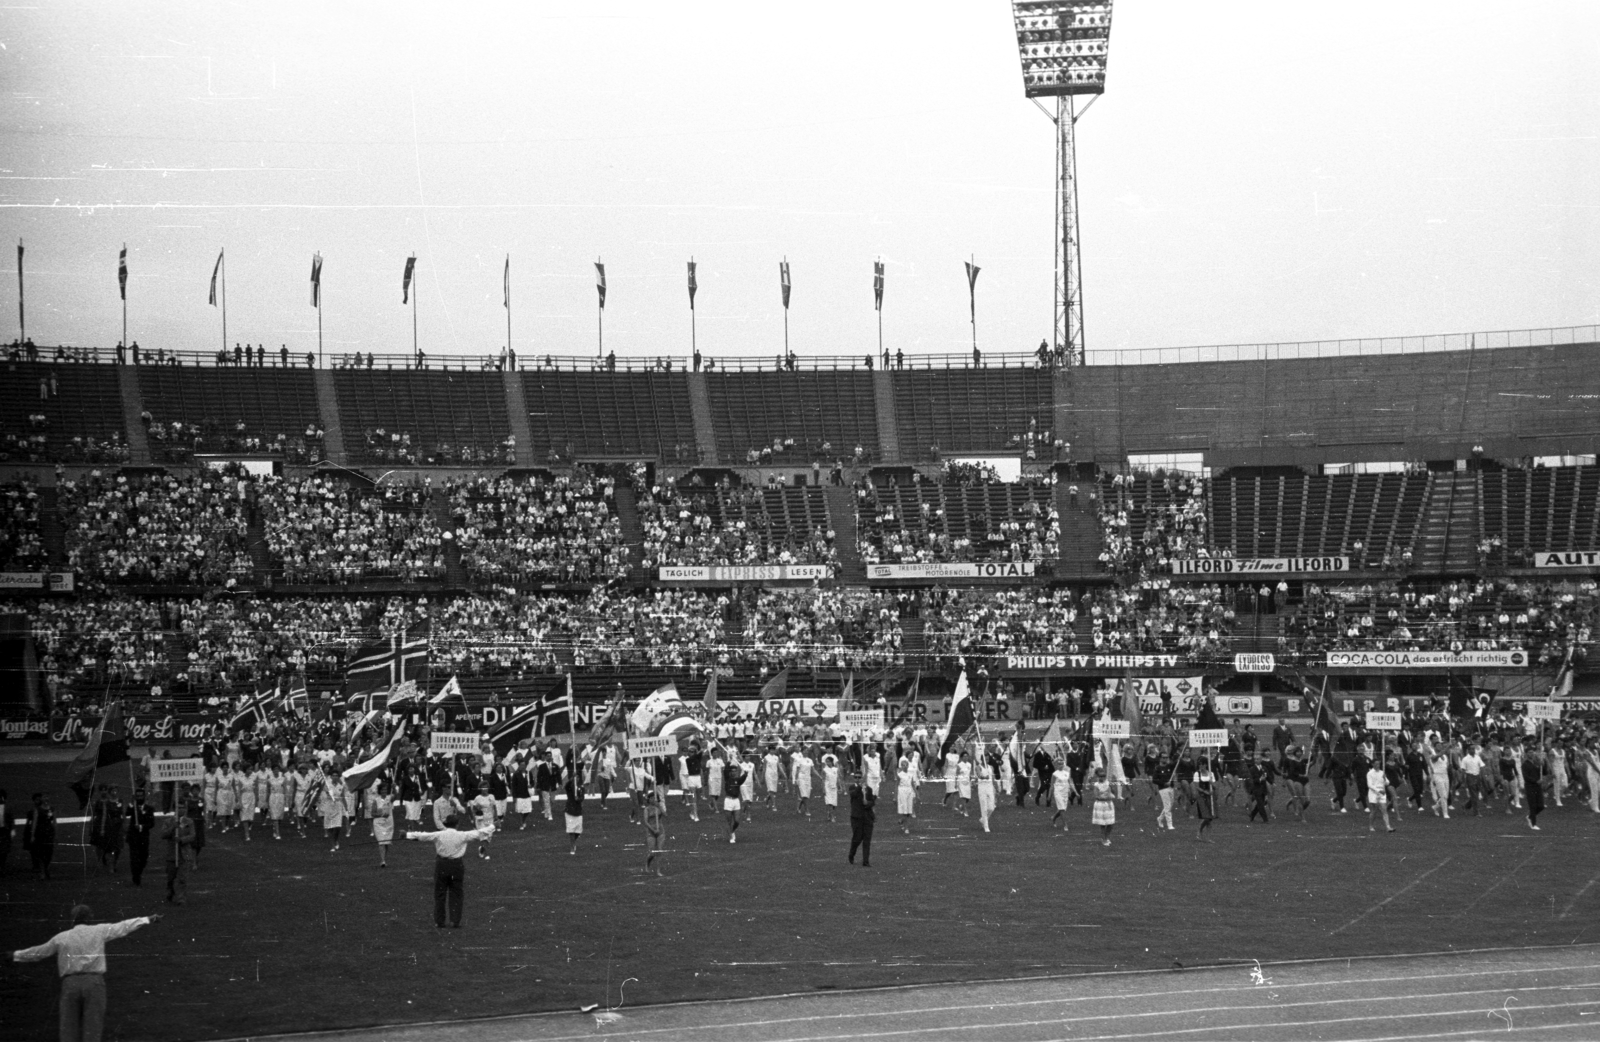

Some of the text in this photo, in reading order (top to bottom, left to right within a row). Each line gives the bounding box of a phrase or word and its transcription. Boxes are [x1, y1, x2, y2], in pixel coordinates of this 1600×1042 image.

[925, 568, 971, 577] MOTORENÖLE
[974, 563, 1030, 577] TOTAL
[1179, 557, 1343, 574] ILFORD Filme ILFORD
[665, 566, 822, 580] TÄGLICH EXPRESS LESEN
[1007, 654, 1178, 669] PHILIPS TV PHILIPS TV
[1238, 654, 1271, 671] EXPRESS
[1331, 653, 1411, 665] COCA-COLA
[1412, 654, 1431, 663] das
[1432, 653, 1474, 663] erfrischt
[1476, 653, 1508, 665] richtig
[755, 699, 810, 718] ARAL
[158, 762, 196, 771] VENEZUELA
